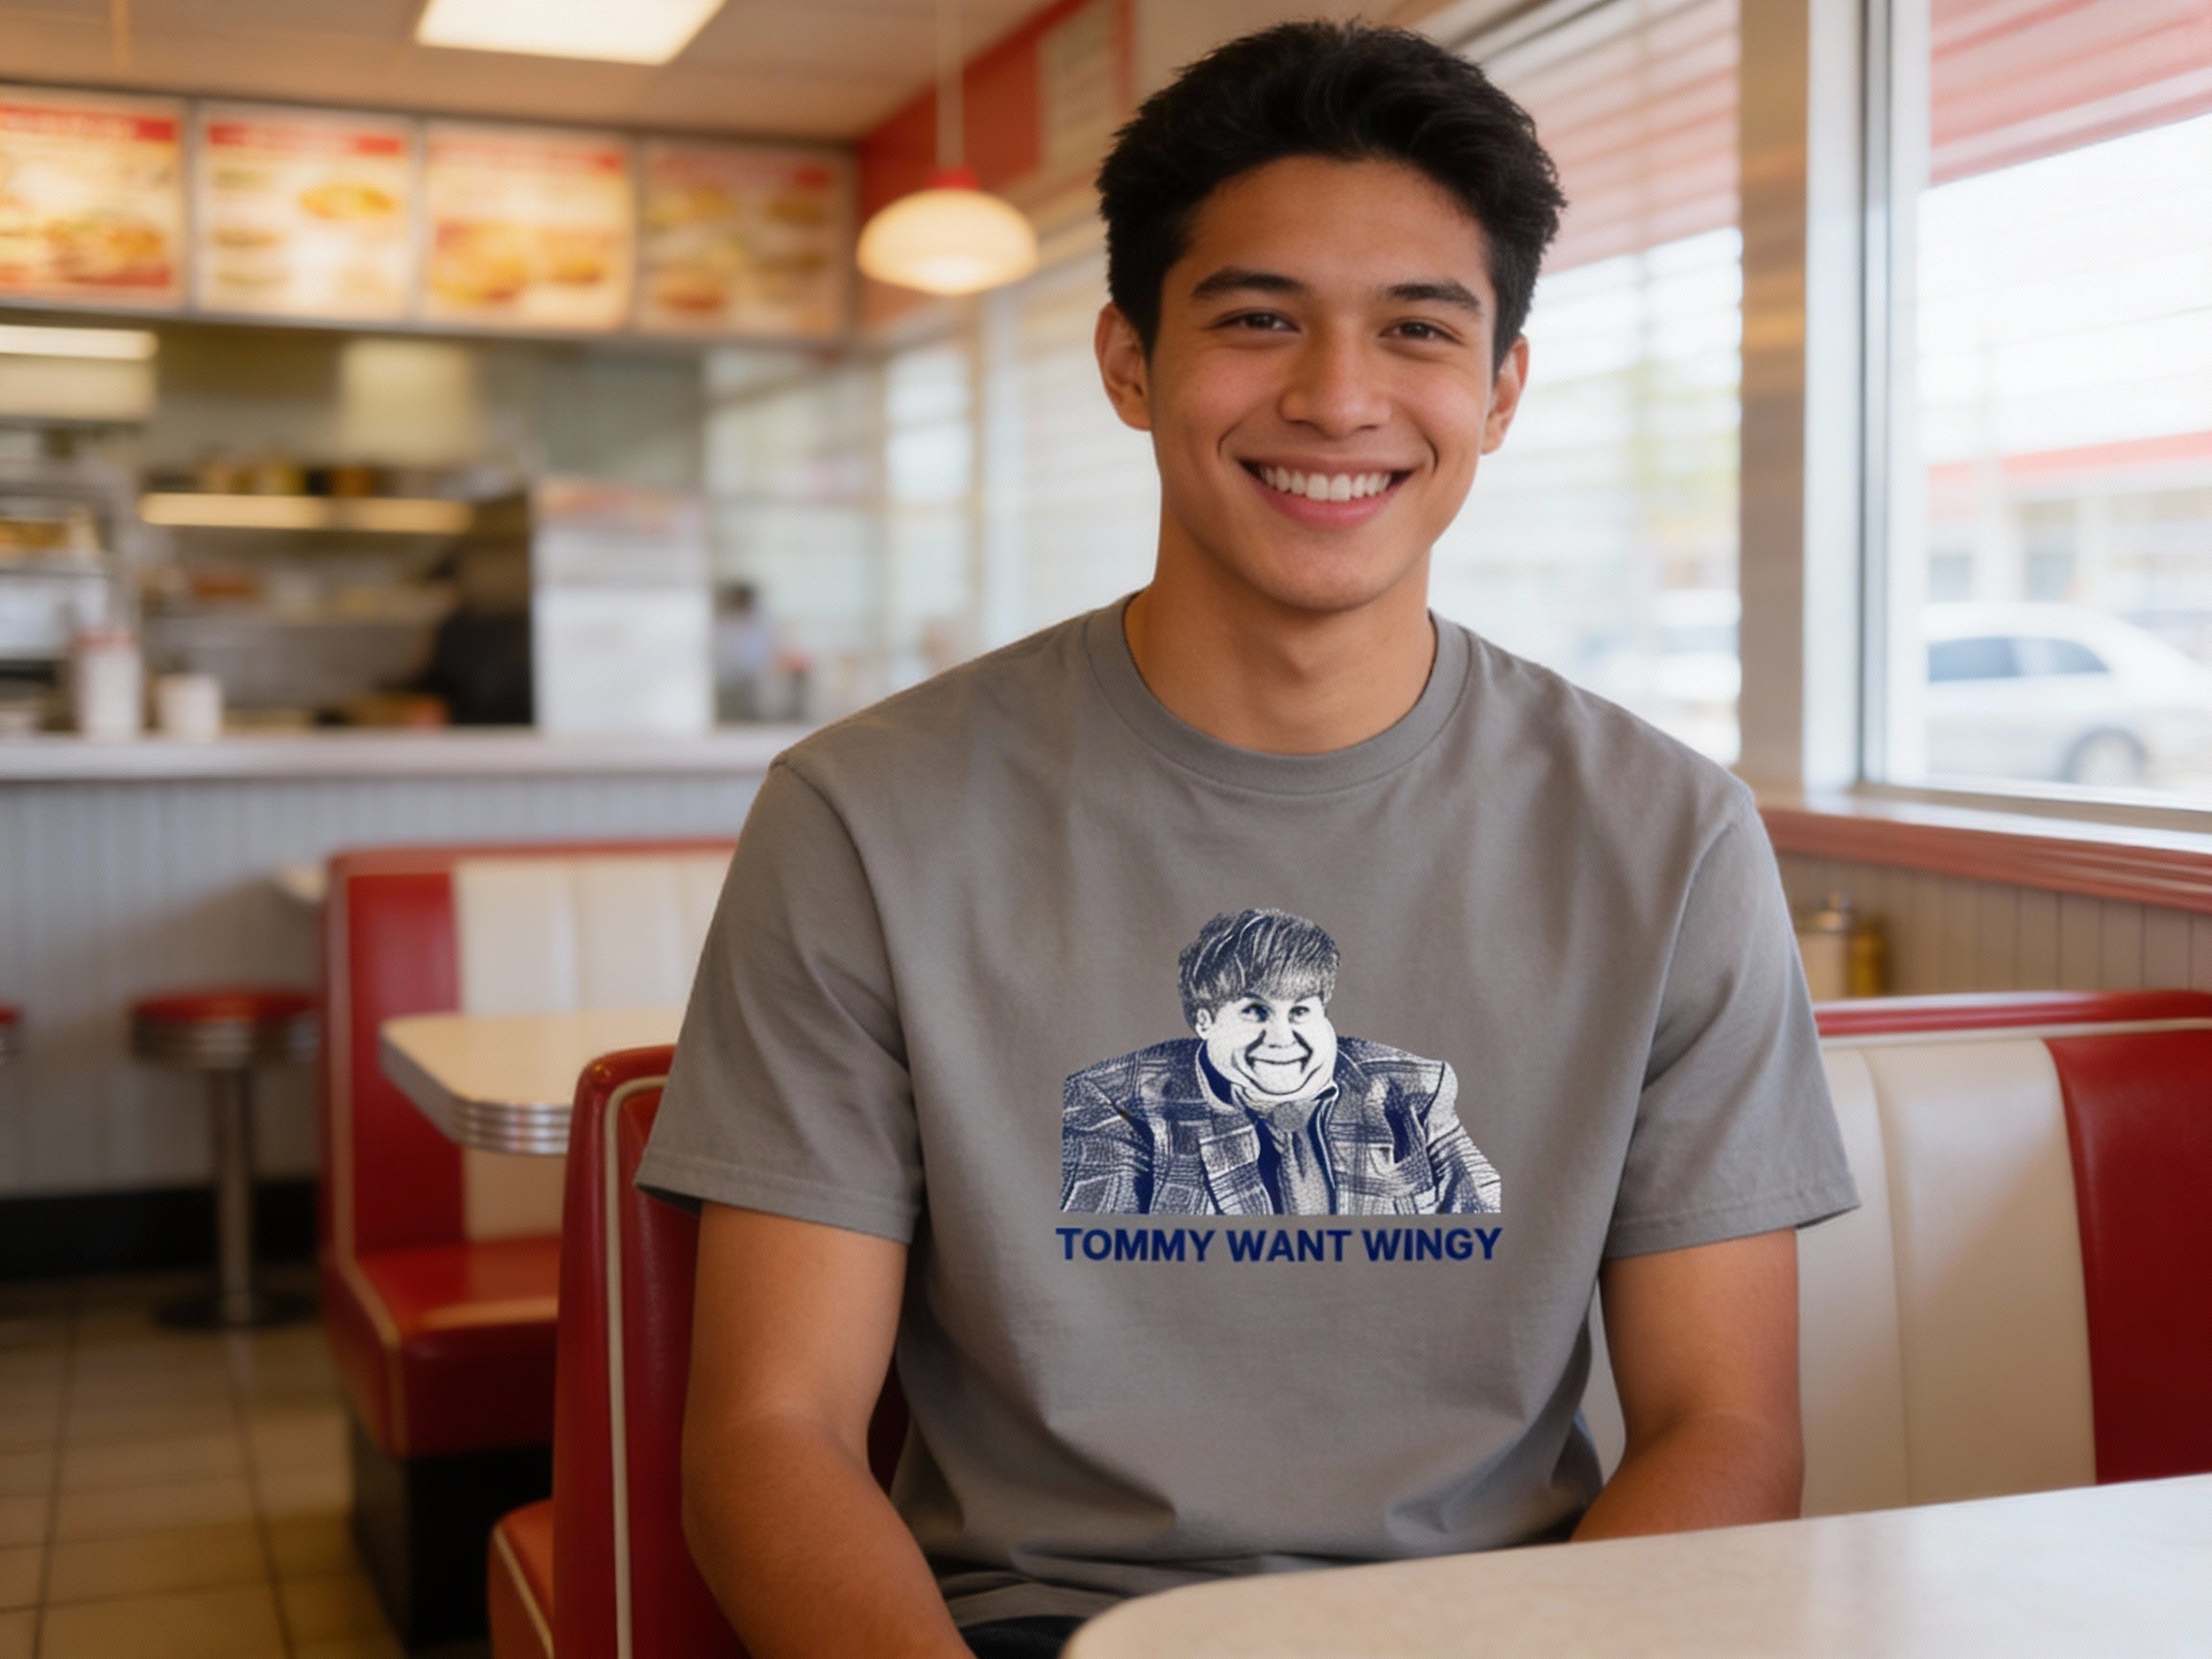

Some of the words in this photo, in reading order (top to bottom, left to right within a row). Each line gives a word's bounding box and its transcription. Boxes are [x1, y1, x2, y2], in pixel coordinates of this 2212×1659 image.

[1056, 1227, 1215, 1262] TOMMY
[1226, 1229, 1353, 1262] WANT
[1362, 1227, 1503, 1262] WINGY
